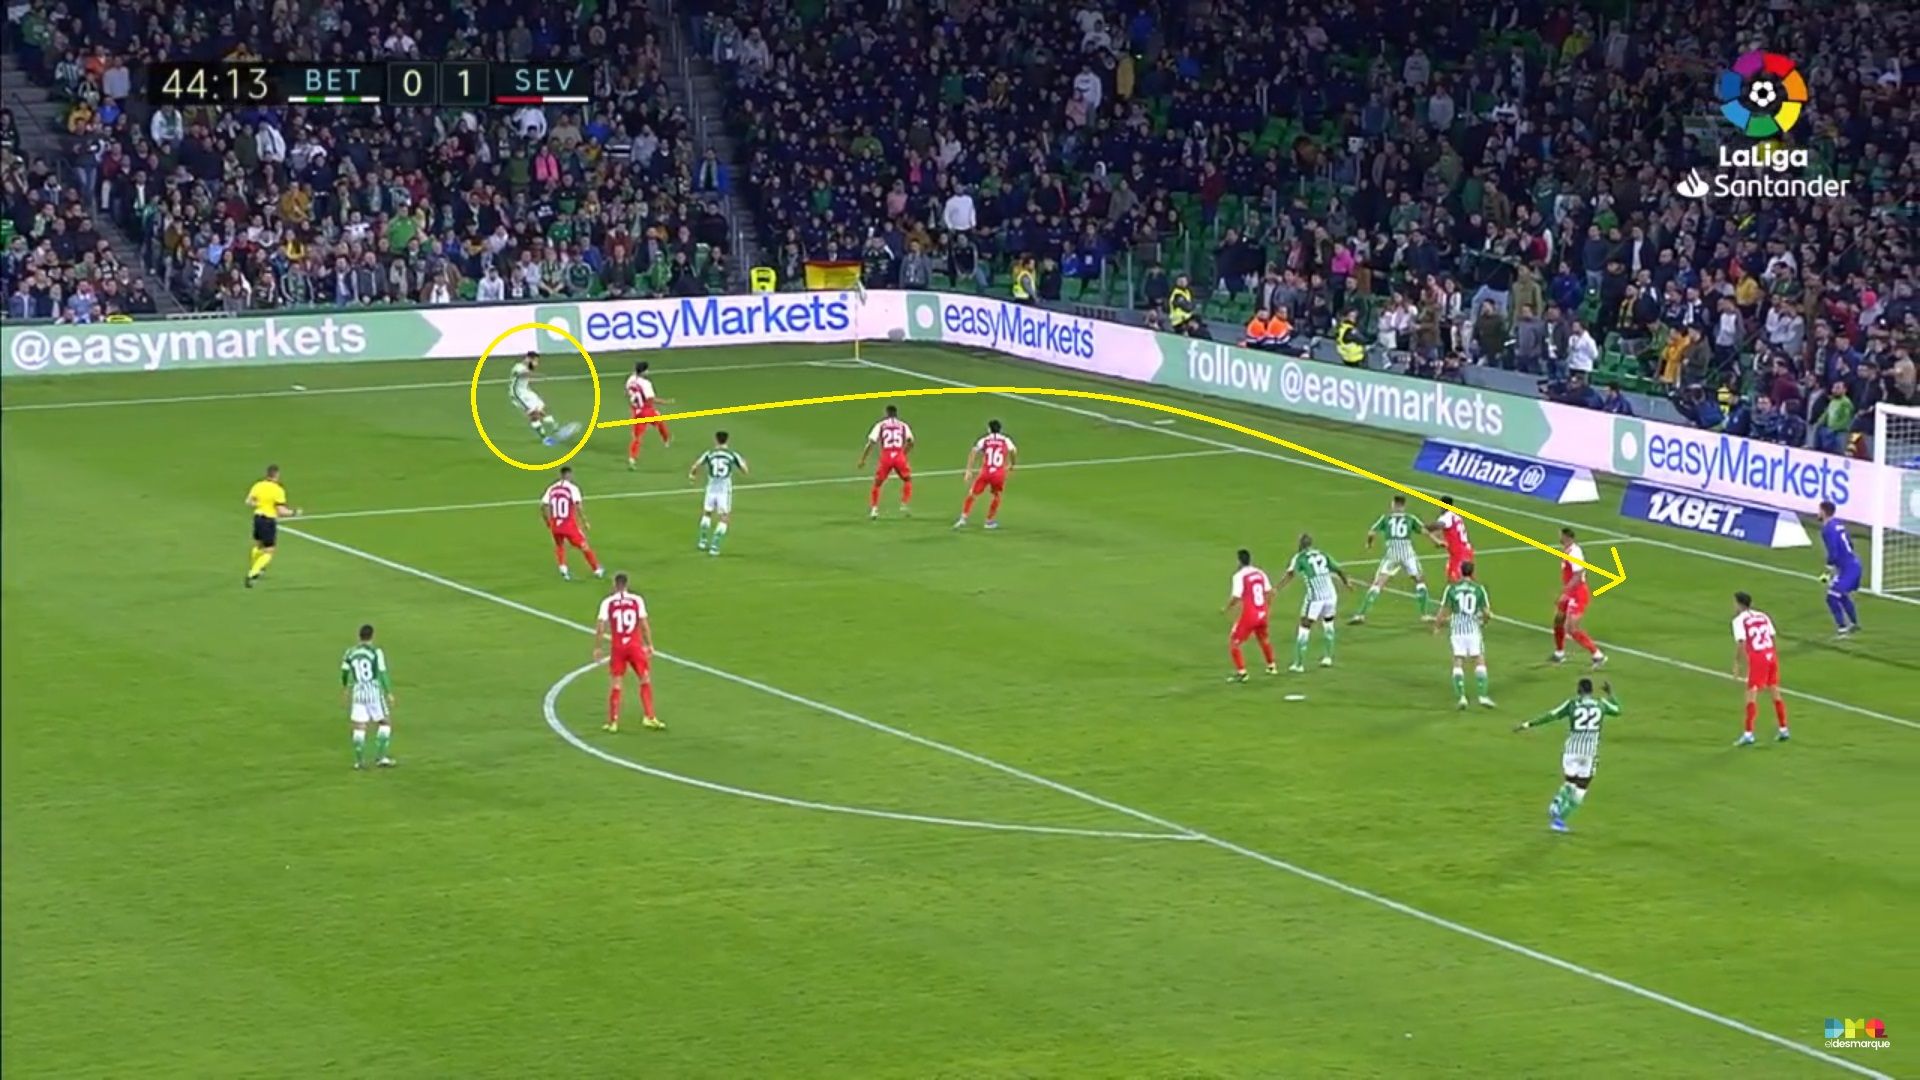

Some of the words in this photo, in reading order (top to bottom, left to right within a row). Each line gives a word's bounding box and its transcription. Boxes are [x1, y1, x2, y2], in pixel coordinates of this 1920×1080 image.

[586, 293, 849, 347] easyMarkets
[944, 303, 1095, 359] easyMarkets
[10, 317, 367, 371] @easymarkets
[1187, 345, 1272, 395] follow
[1280, 363, 1503, 436] @easymarkets
[882, 429, 903, 448] 25
[711, 457, 729, 476] 15
[985, 446, 1003, 467] 16
[1438, 447, 1520, 487] Allianz
[1648, 431, 1853, 506] easyMarkets
[550, 496, 570, 519] 10
[1387, 516, 1408, 538] 16
[1307, 554, 1330, 575] 12
[1252, 582, 1265, 607] 8
[1455, 591, 1477, 614] 10
[612, 608, 637, 634] 19
[1749, 625, 1774, 650] 23
[350, 658, 374, 681] 18
[1574, 707, 1602, 730] 22
